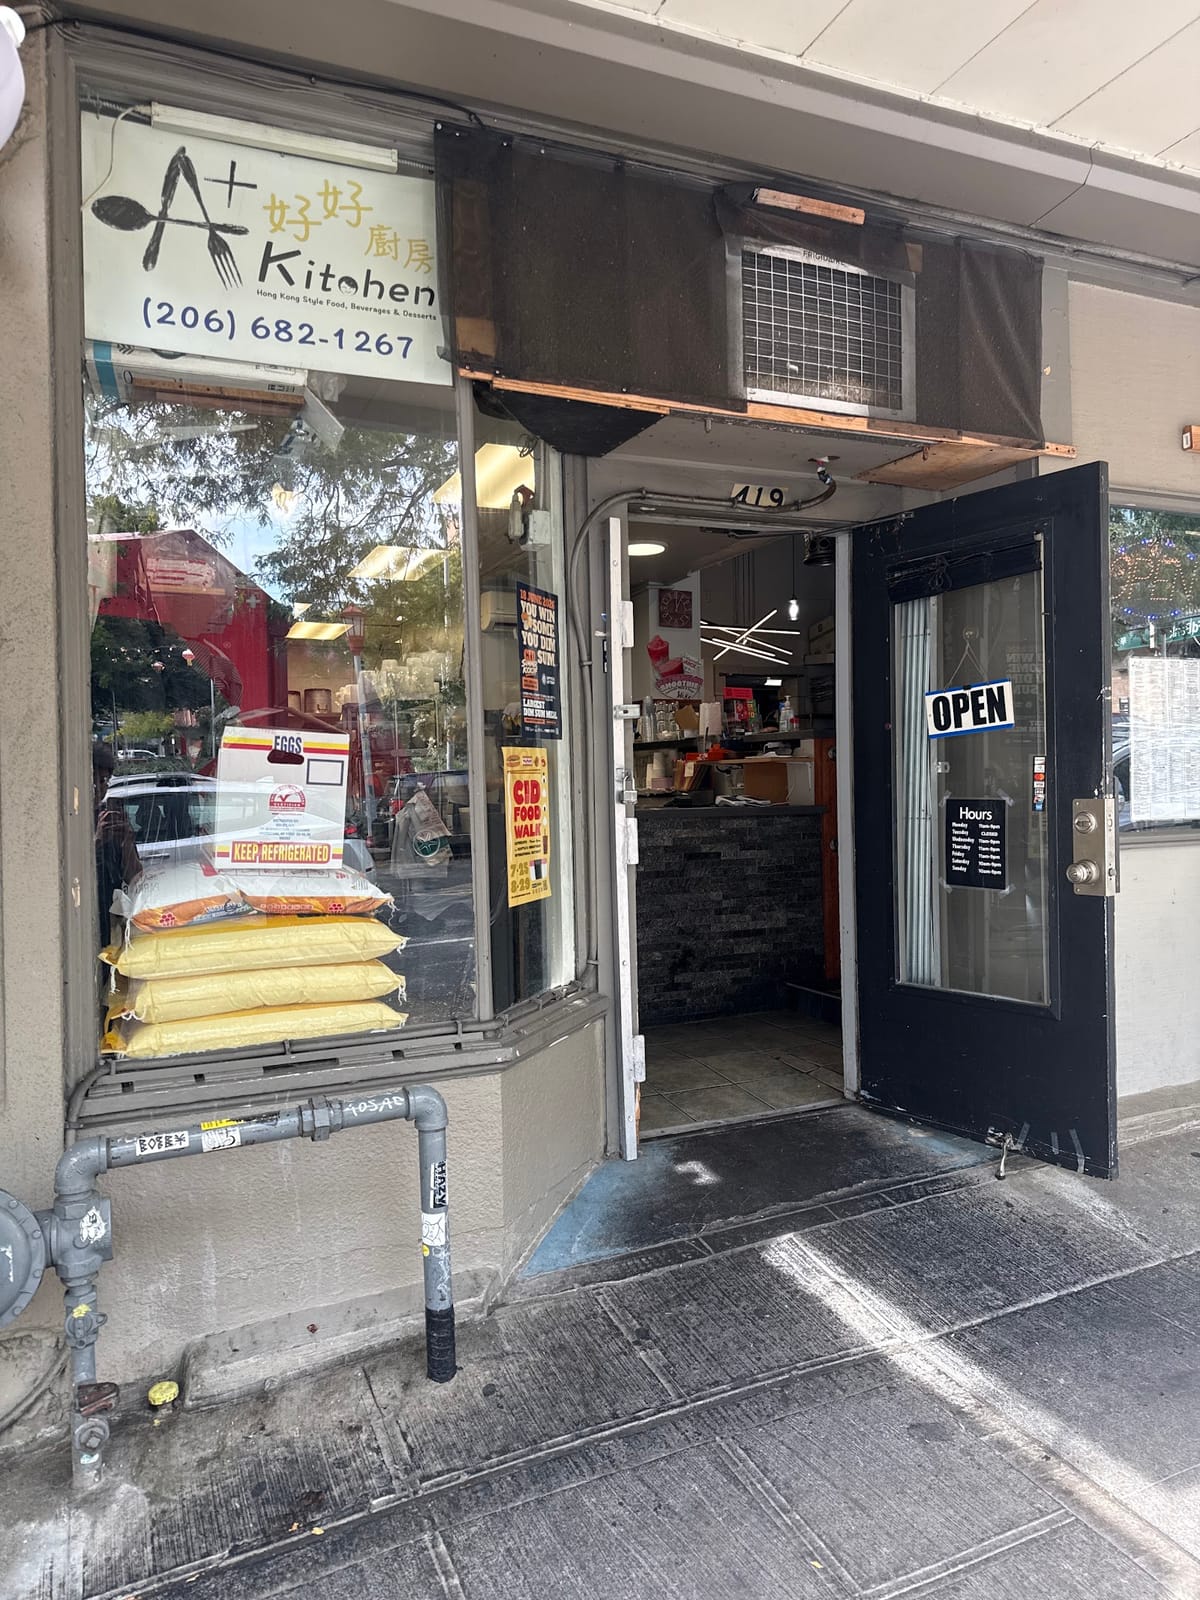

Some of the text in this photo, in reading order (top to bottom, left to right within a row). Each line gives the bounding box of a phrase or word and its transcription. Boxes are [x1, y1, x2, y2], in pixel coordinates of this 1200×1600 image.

[263, 179, 374, 242] 好好
[257, 288, 437, 321] Hong Kong Style Food, Beverages & Desserts
[143, 296, 414, 359] (206) 682-1267
[734, 485, 784, 508] 419
[520, 599, 556, 624] YOU WIN
[532, 618, 555, 637] SOME
[521, 630, 556, 653] YOU DIM
[537, 649, 556, 667] SUM
[932, 685, 1007, 731] OPEN
[274, 735, 303, 754] EGGS
[513, 779, 541, 805] CID
[514, 805, 541, 822] FOOD
[960, 806, 992, 820] Hours
[514, 822, 542, 839] WALK
[233, 843, 329, 862] KEEP REFRIGERATED
